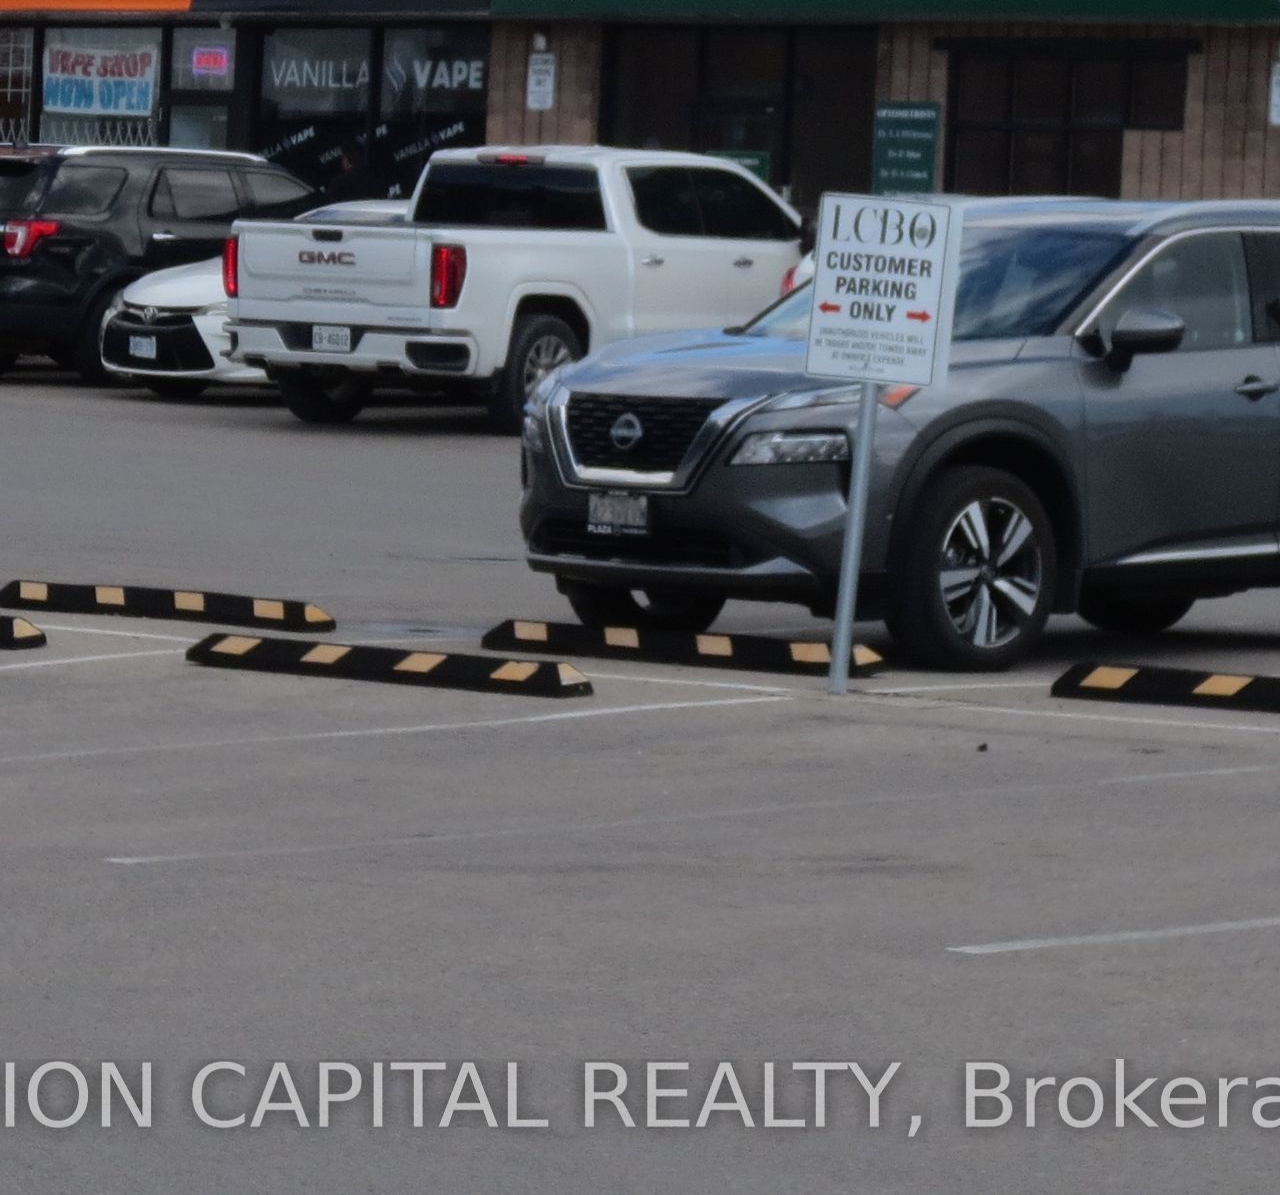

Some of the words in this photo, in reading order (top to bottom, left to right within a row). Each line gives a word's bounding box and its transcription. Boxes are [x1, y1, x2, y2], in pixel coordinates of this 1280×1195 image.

[271, 60, 369, 88] VANILLA
[413, 60, 483, 89] VAPE
[832, 204, 937, 248] LCBO
[299, 251, 356, 265] GMC
[826, 251, 932, 278] CUSTOMER
[835, 276, 917, 300] PARKING
[849, 301, 896, 322] ONLY
